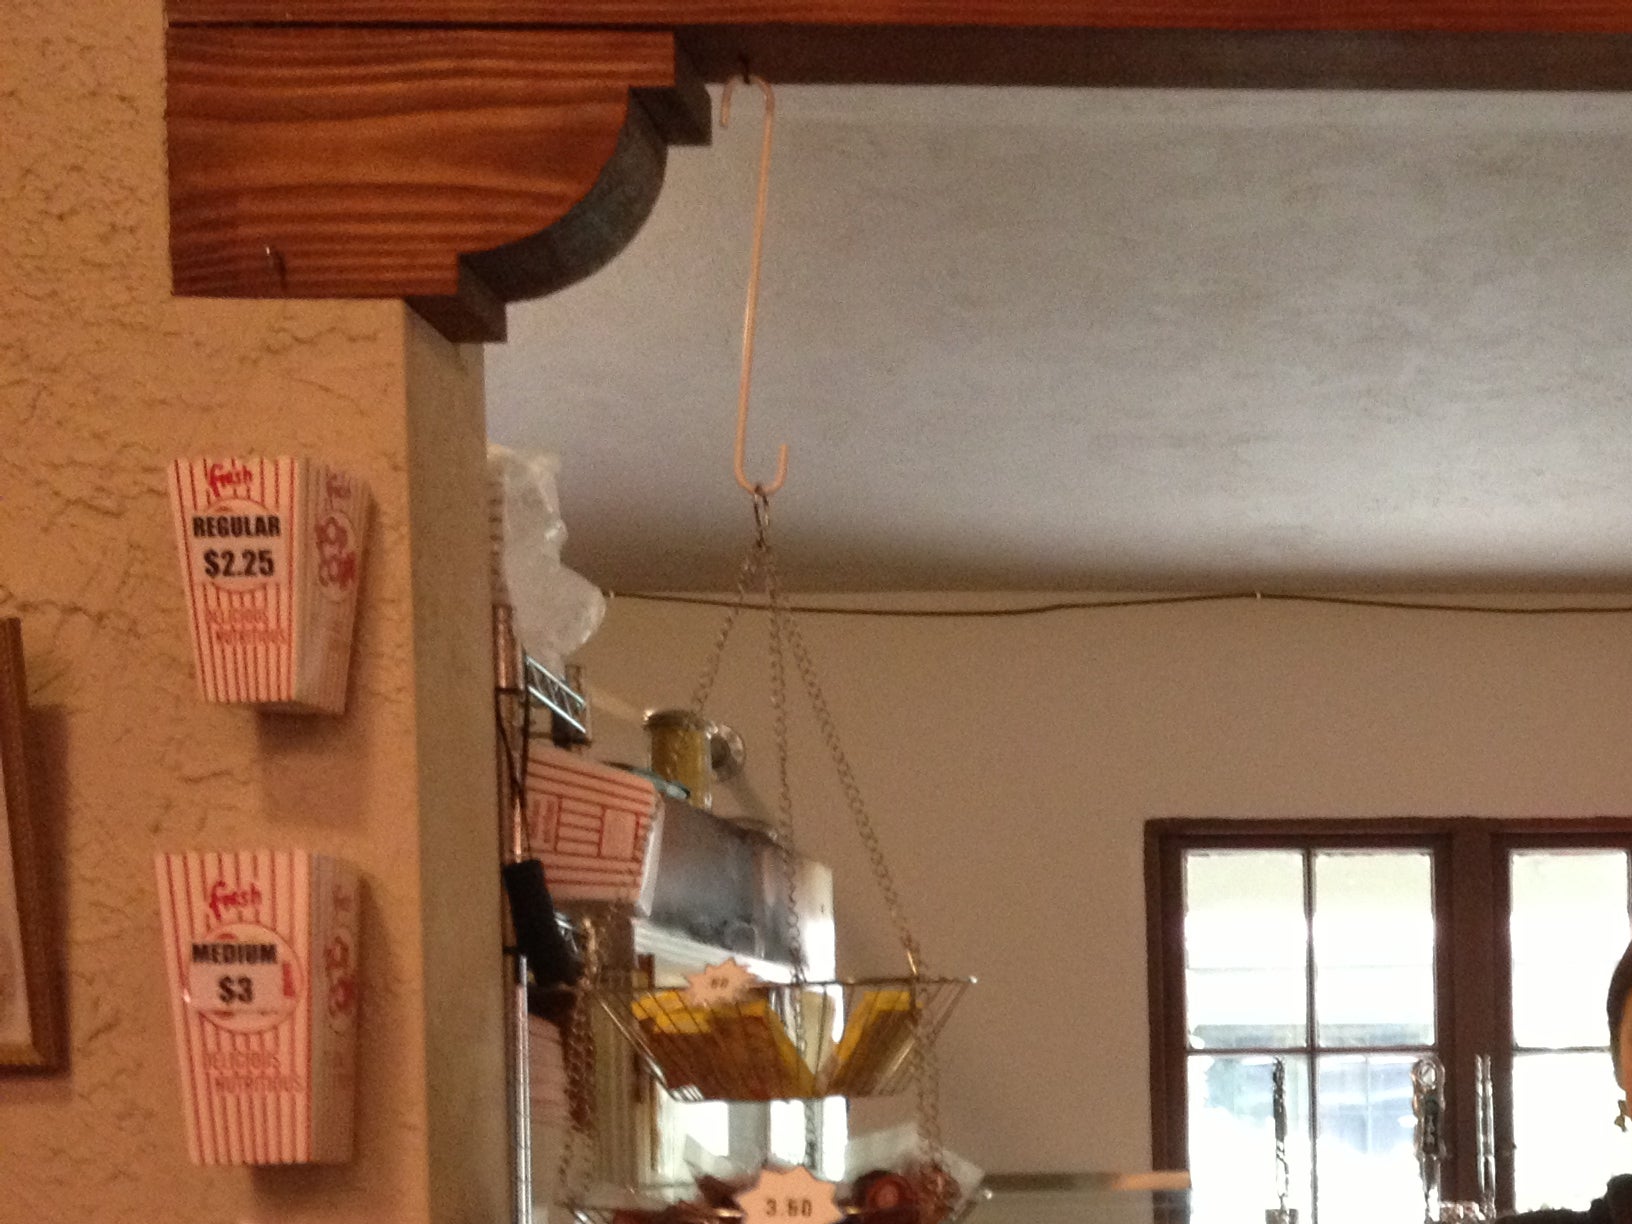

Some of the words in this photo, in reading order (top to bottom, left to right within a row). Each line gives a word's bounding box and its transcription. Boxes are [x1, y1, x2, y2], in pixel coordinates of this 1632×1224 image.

[193, 515, 281, 538] REGULAR
[203, 549, 275, 578] $2.25
[192, 943, 277, 965] MEDIUM
[218, 975, 253, 1004] $3
